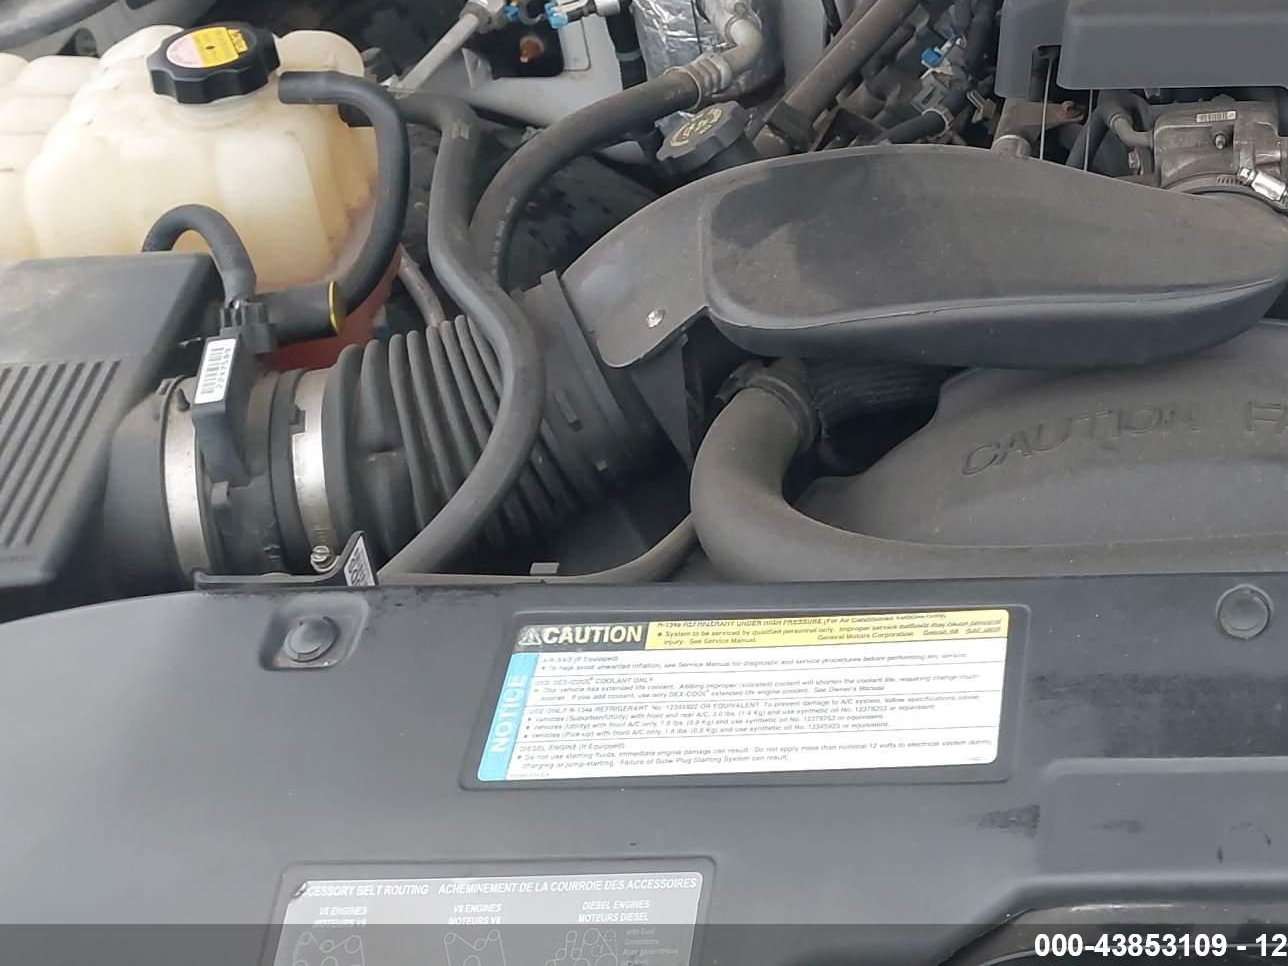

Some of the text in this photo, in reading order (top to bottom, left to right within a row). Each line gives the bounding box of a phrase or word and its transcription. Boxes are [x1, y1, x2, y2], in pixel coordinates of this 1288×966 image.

[961, 404, 1201, 476] CAUTION
[542, 625, 643, 644] CAUTION
[817, 633, 844, 641] General
[356, 884, 429, 896] BELT ROUTING
[438, 878, 697, 894] ACHEMINEMENT DE LA COURROIE DES ACCESSOIRES
[464, 903, 503, 913] ENGINES
[582, 899, 650, 910] DIESEL ENGINES
[578, 912, 649, 923] MOTEURS DIESEL
